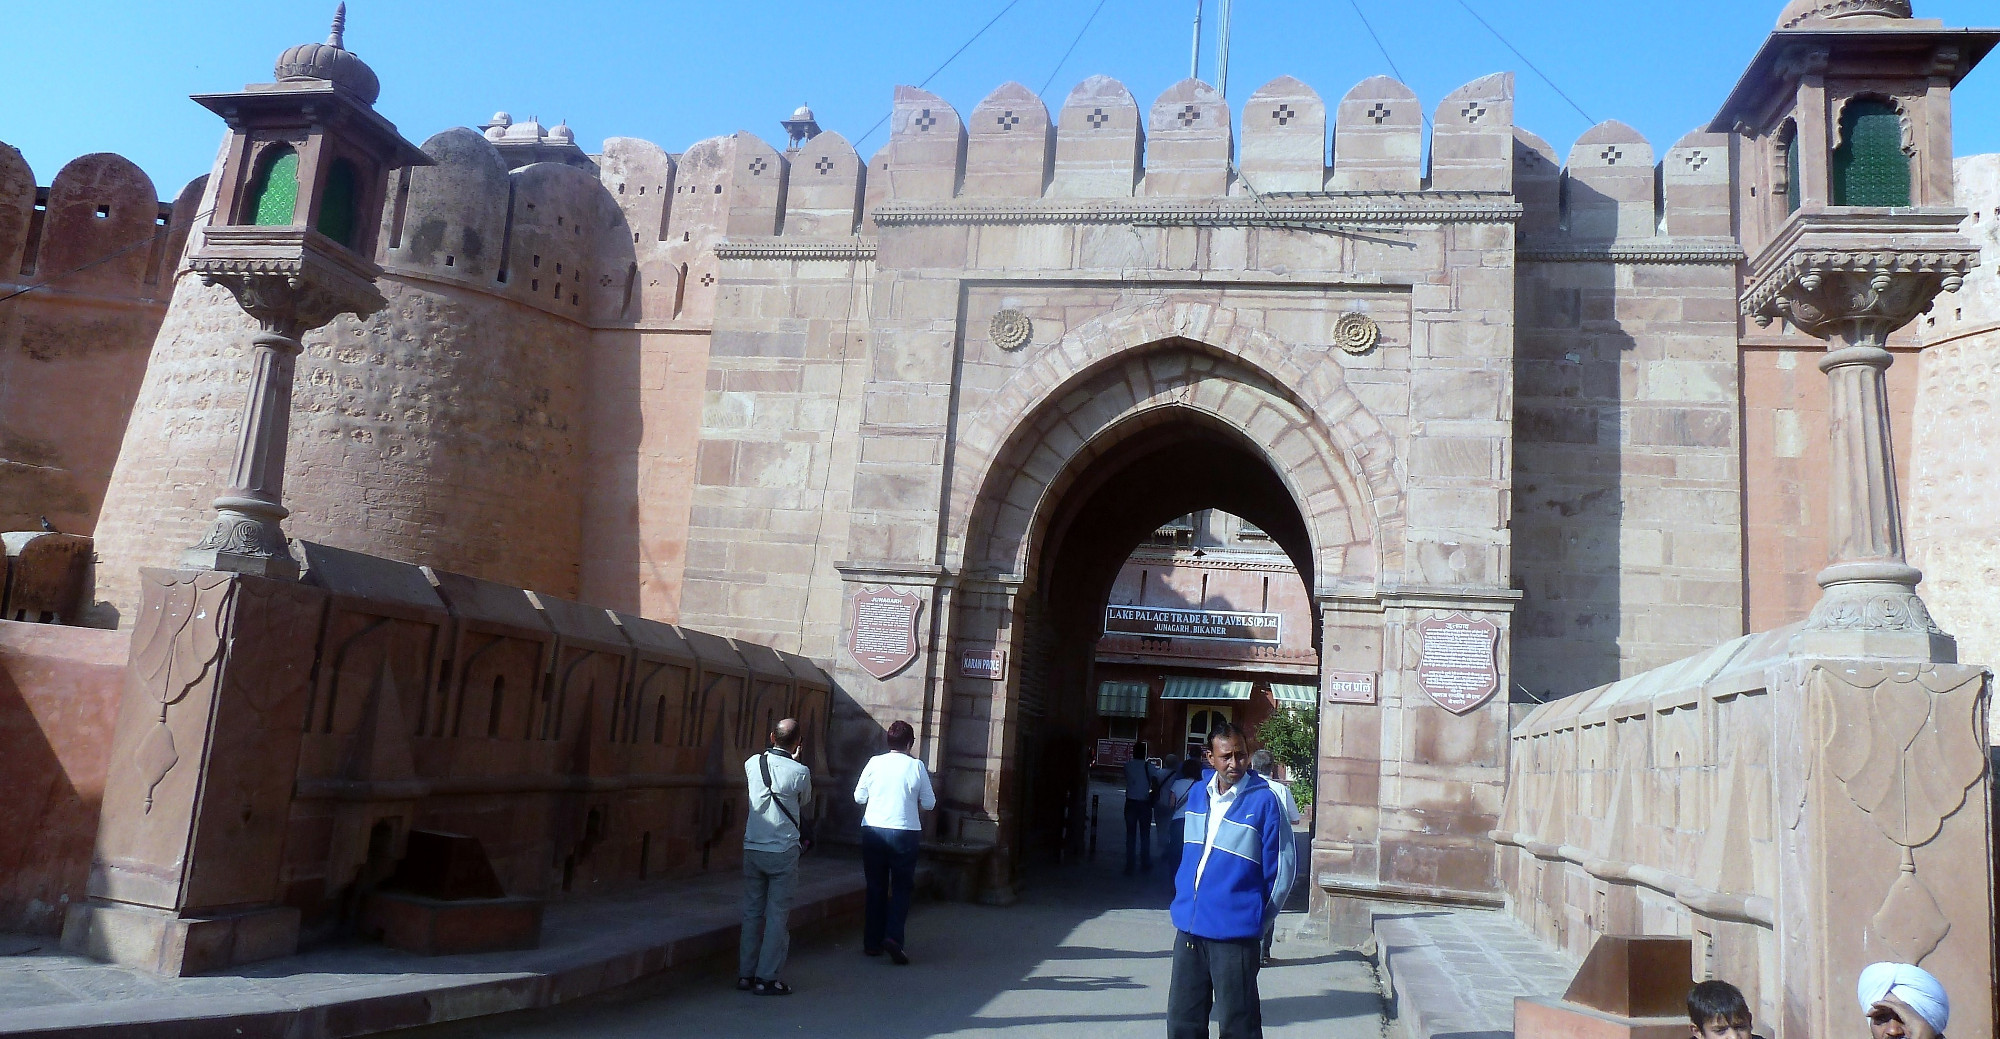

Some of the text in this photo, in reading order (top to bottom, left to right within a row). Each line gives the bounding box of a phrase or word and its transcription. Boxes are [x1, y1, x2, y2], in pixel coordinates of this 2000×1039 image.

[1109, 609, 1134, 620] LAKE
[1135, 611, 1170, 622] PALACE
[1171, 613, 1201, 624] TRADE
[1202, 615, 1210, 624] &
[1193, 625, 1226, 635] BIKANER
[964, 658, 982, 669] KARAN
[1332, 680, 1352, 692] करन
